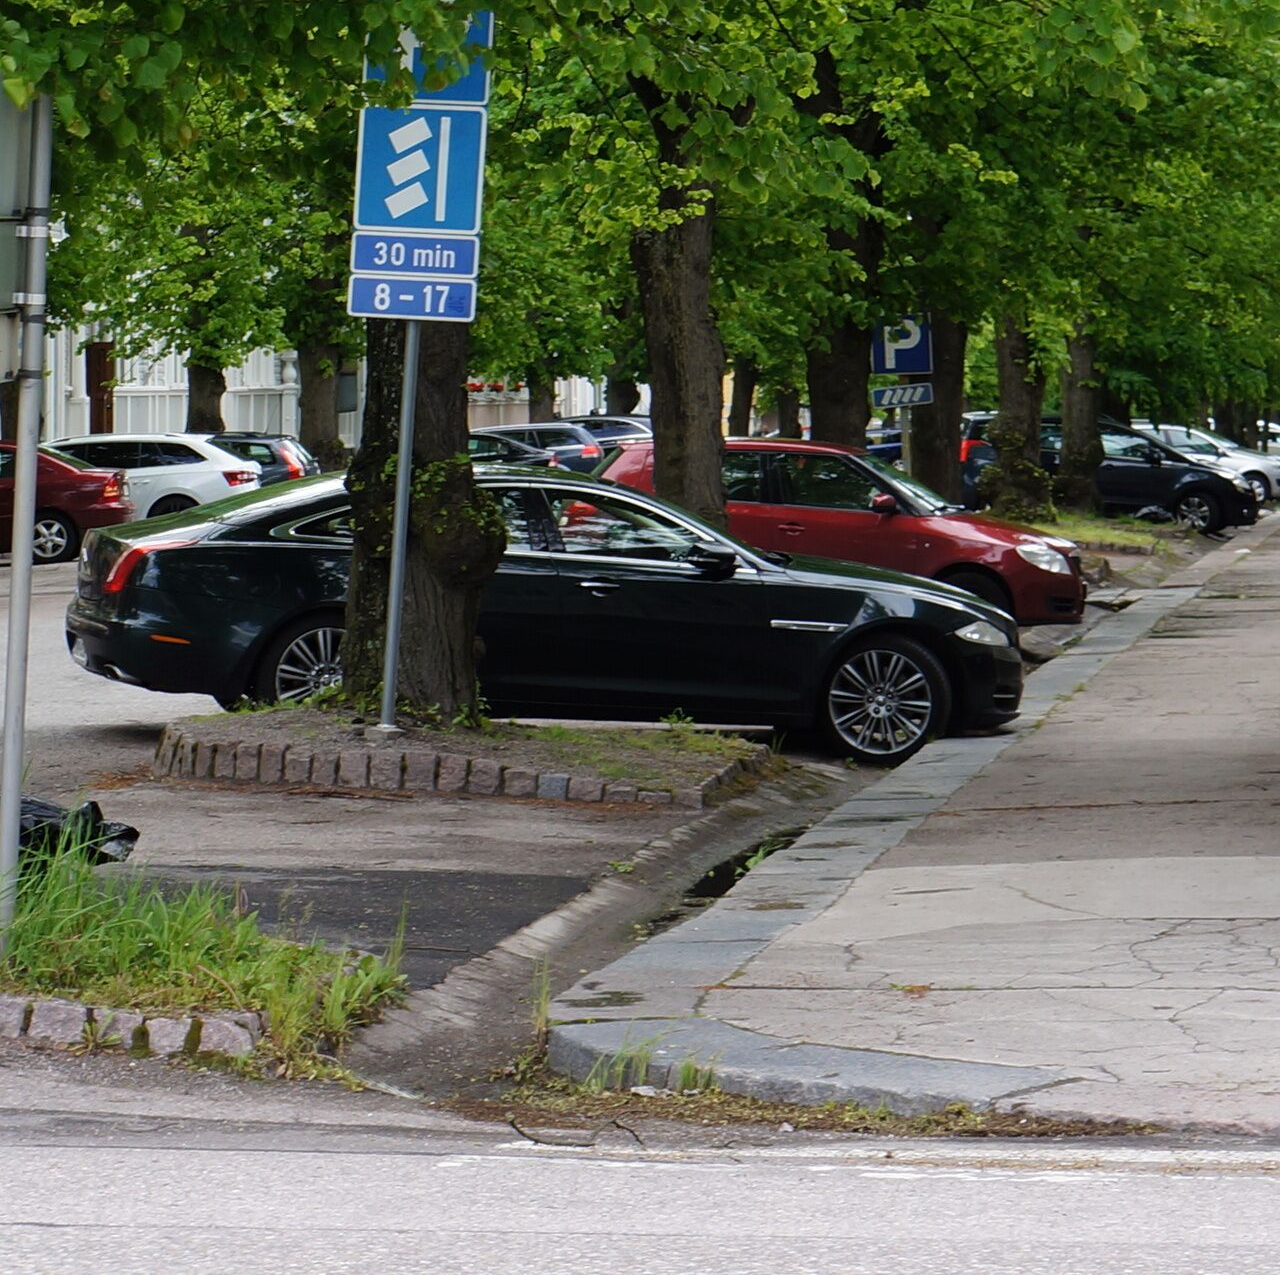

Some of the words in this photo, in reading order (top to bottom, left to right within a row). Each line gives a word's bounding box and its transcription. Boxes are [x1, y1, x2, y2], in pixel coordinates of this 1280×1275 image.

[373, 241, 406, 266] 30
[412, 244, 456, 269] min
[883, 319, 922, 370] P
